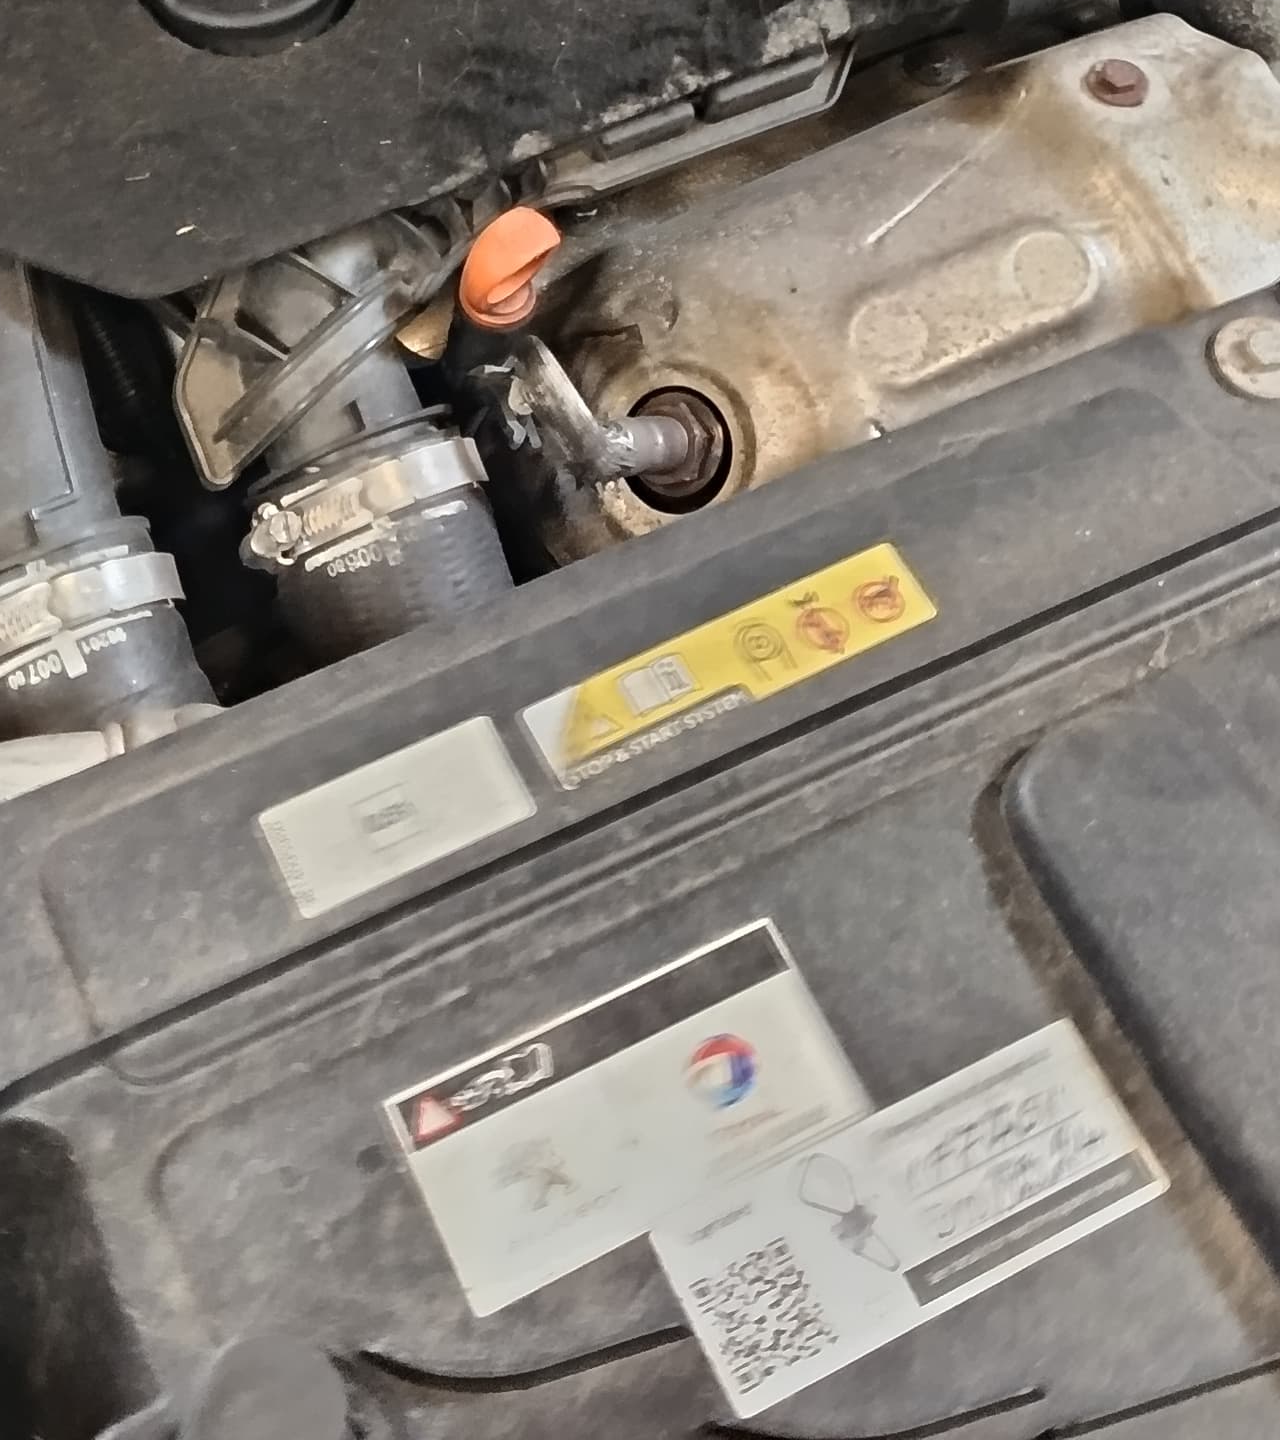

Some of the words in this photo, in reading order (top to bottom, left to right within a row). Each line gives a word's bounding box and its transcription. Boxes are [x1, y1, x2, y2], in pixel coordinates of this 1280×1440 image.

[29, 654, 62, 685] 007
[565, 754, 614, 788] STOP
[631, 718, 684, 754] START
[683, 690, 752, 729] SYSTEM
